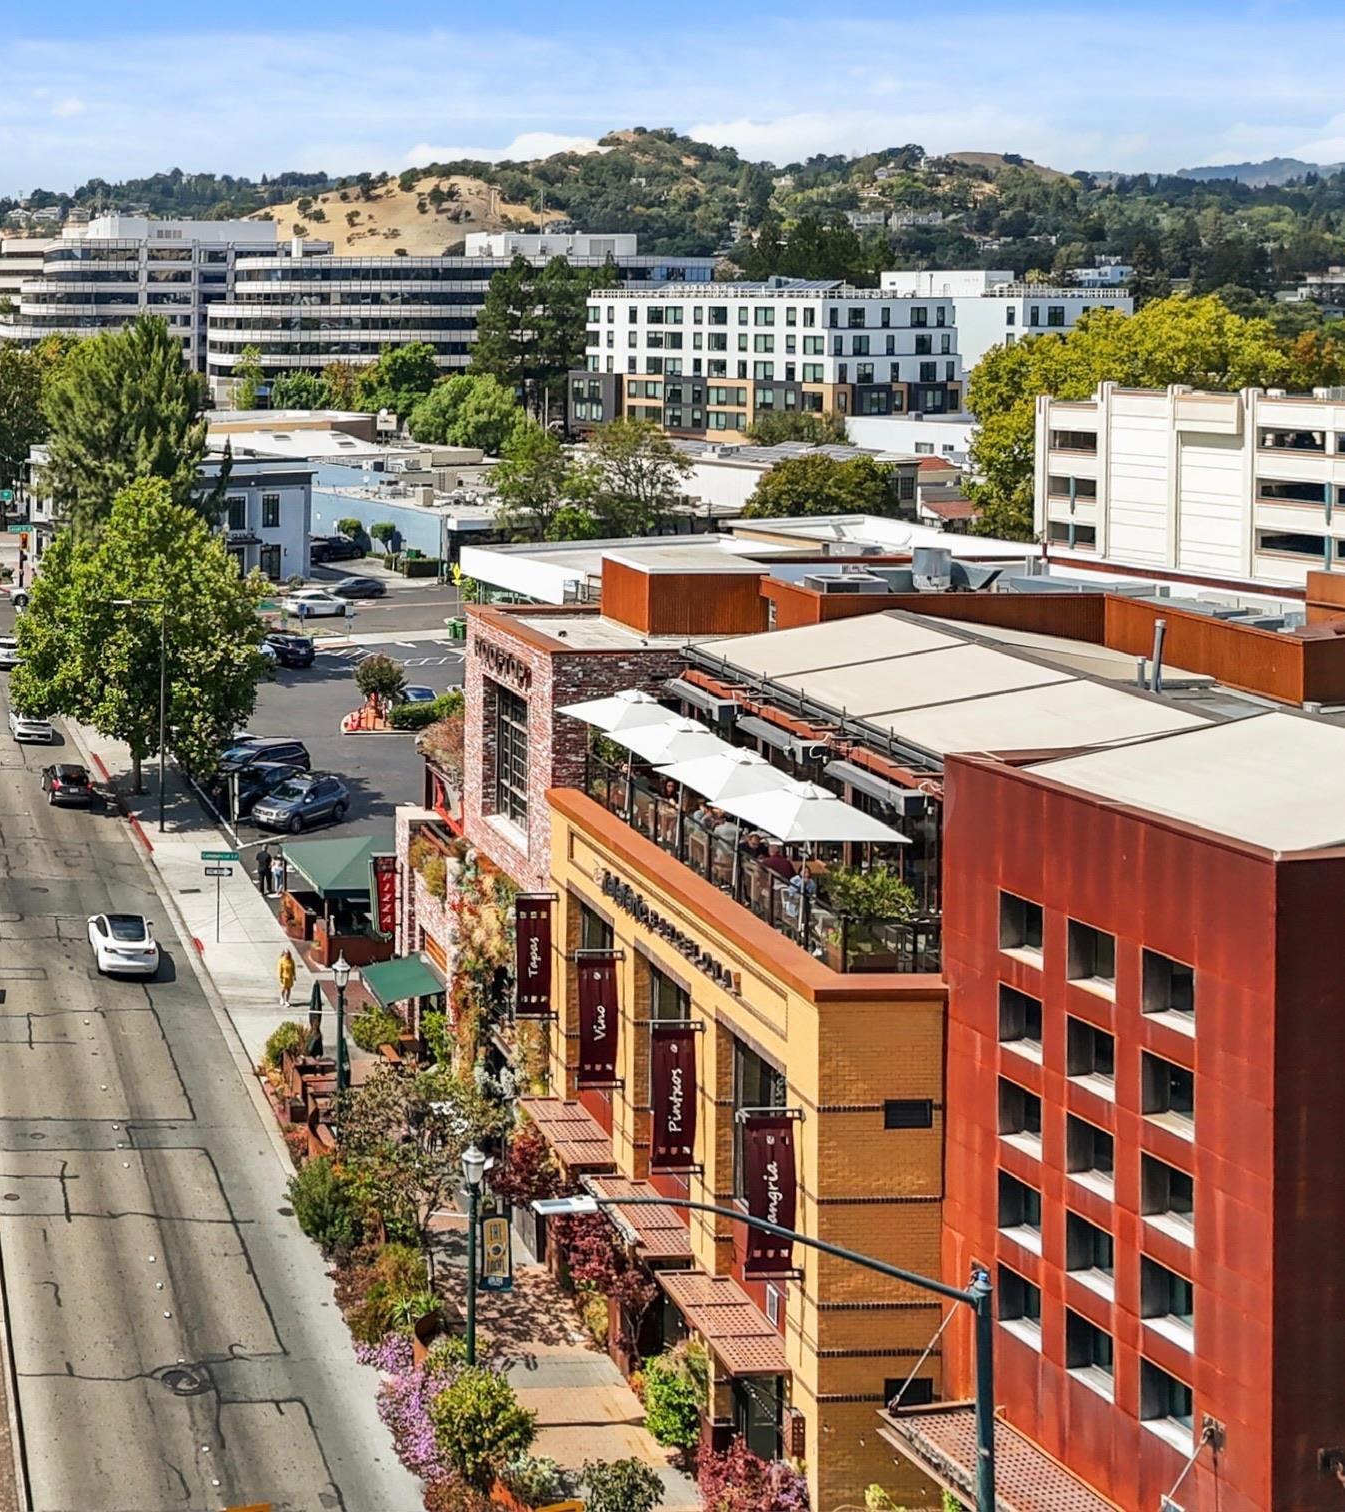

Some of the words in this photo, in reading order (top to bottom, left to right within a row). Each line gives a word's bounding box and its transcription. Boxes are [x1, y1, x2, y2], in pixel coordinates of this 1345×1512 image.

[382, 872, 393, 923] PIZZA
[528, 936, 541, 978] Tapas
[593, 1005, 606, 1041] Vino
[668, 1068, 683, 1132] Pintxos
